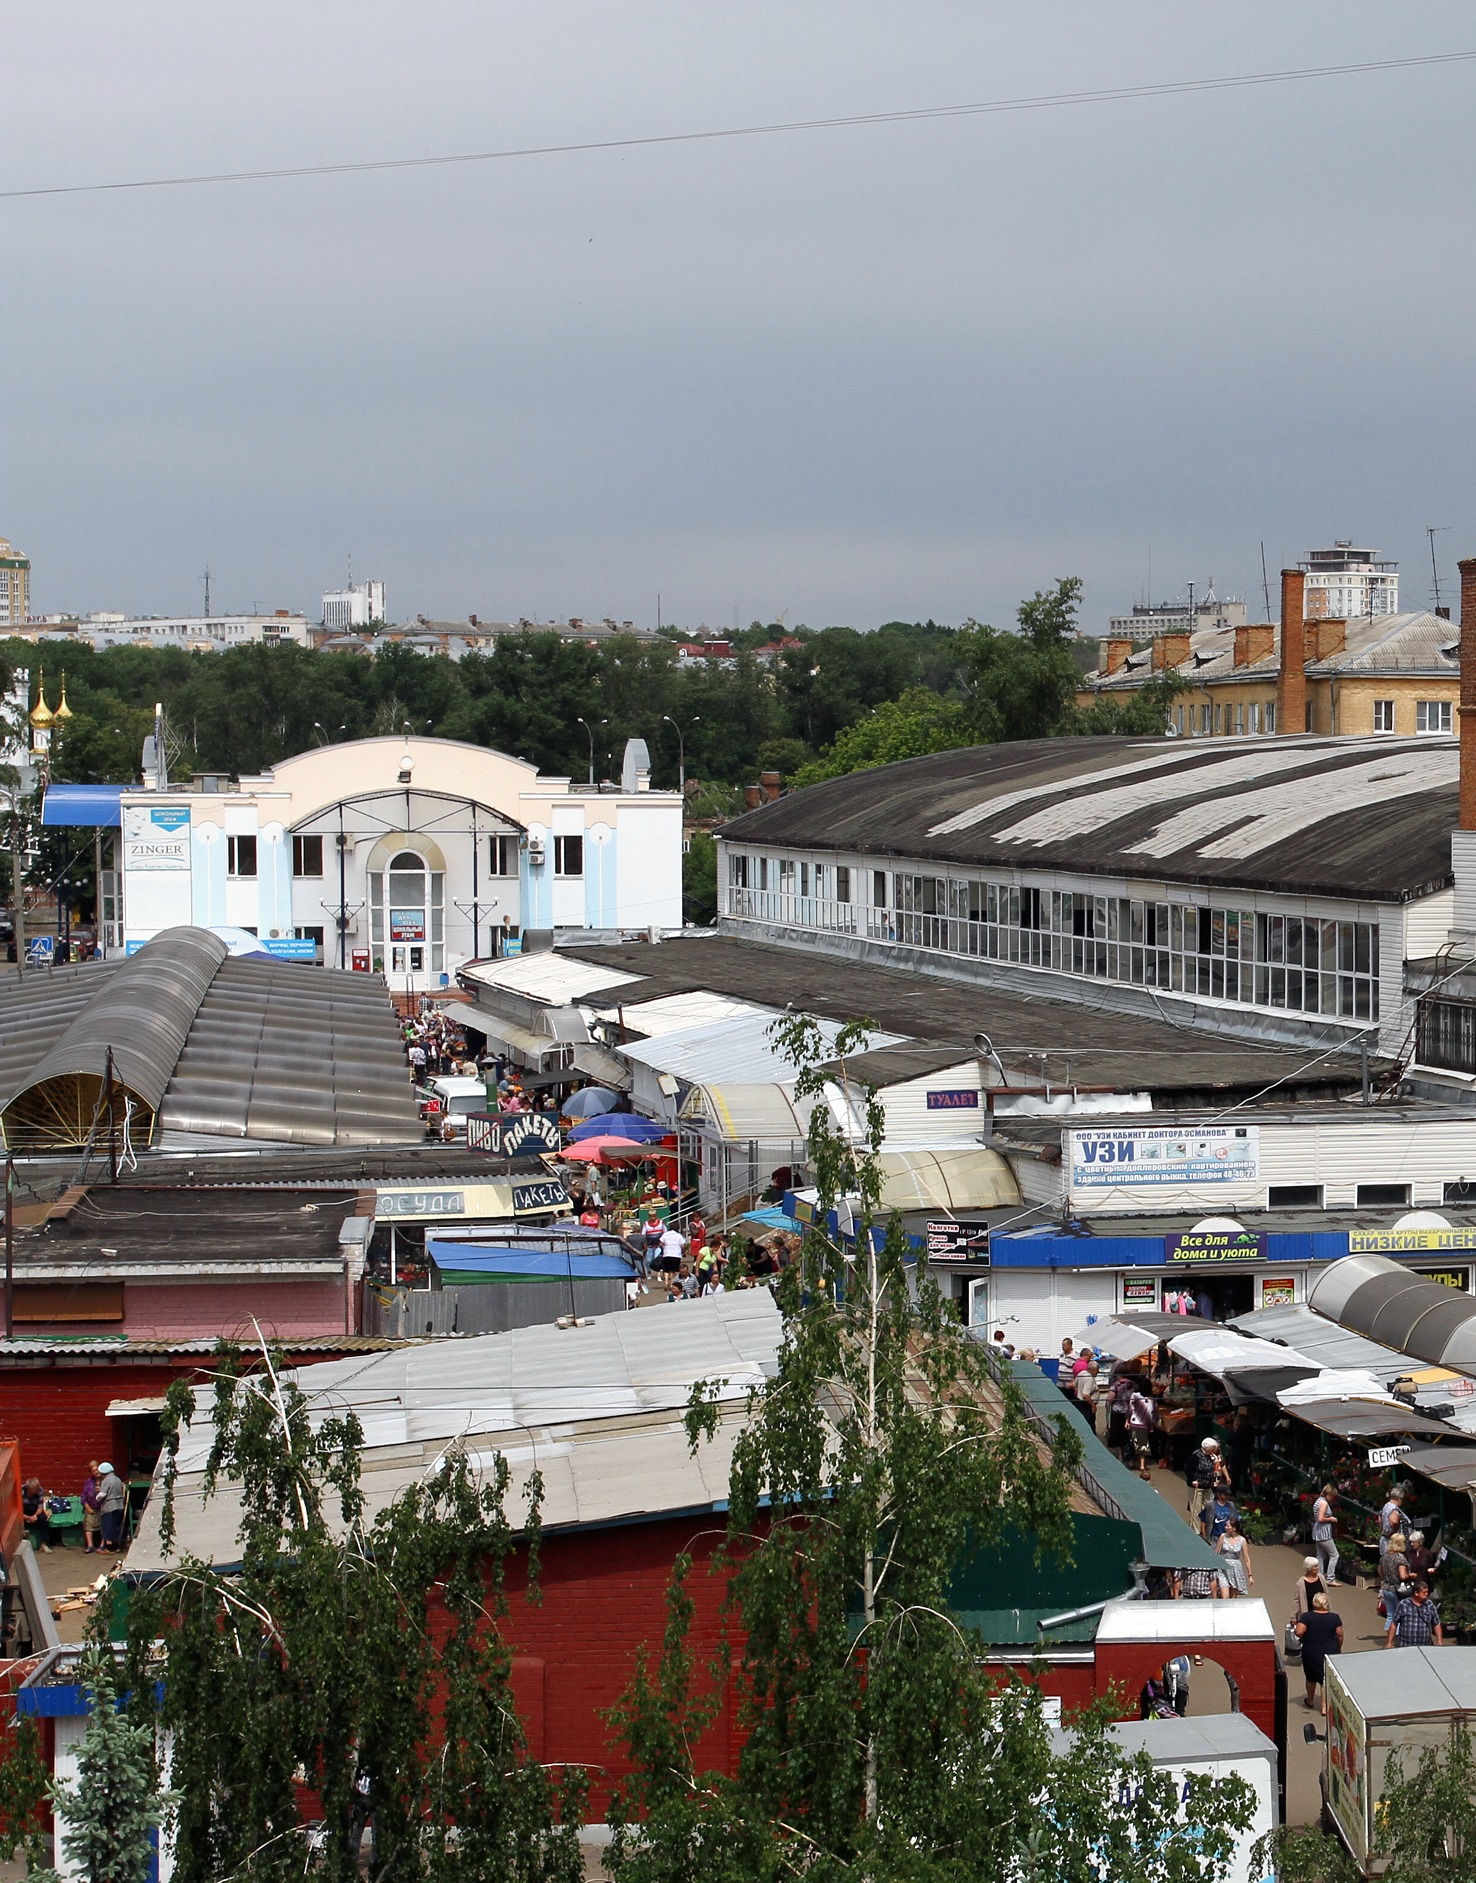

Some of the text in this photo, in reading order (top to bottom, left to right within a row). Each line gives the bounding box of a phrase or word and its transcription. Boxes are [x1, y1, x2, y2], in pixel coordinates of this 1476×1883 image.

[131, 845, 182, 854] ZINGER
[928, 1094, 977, 1106] ТУАЛЕТ
[468, 1118, 500, 1153] ПИВО
[503, 1114, 559, 1156] ПАКЕТЫ
[1112, 1131, 1146, 1139] КАБИНЕТ
[1147, 1130, 1183, 1139] ДОКТОРА
[1082, 1141, 1134, 1163] УЗИ
[1190, 1161, 1255, 1169] картированием
[1107, 1173, 1160, 1182] центрального
[1189, 1172, 1223, 1180] телефон
[1223, 1169, 1255, 1178] 48-40-23
[514, 1184, 565, 1208] ПАКЕТЫ
[928, 1223, 959, 1231] Колготки
[1180, 1233, 1229, 1246] Все для
[1351, 1235, 1428, 1249] НИЗКИЕ
[1173, 1247, 1258, 1260] дома и уюта
[1425, 1273, 1462, 1287] УПЫ
